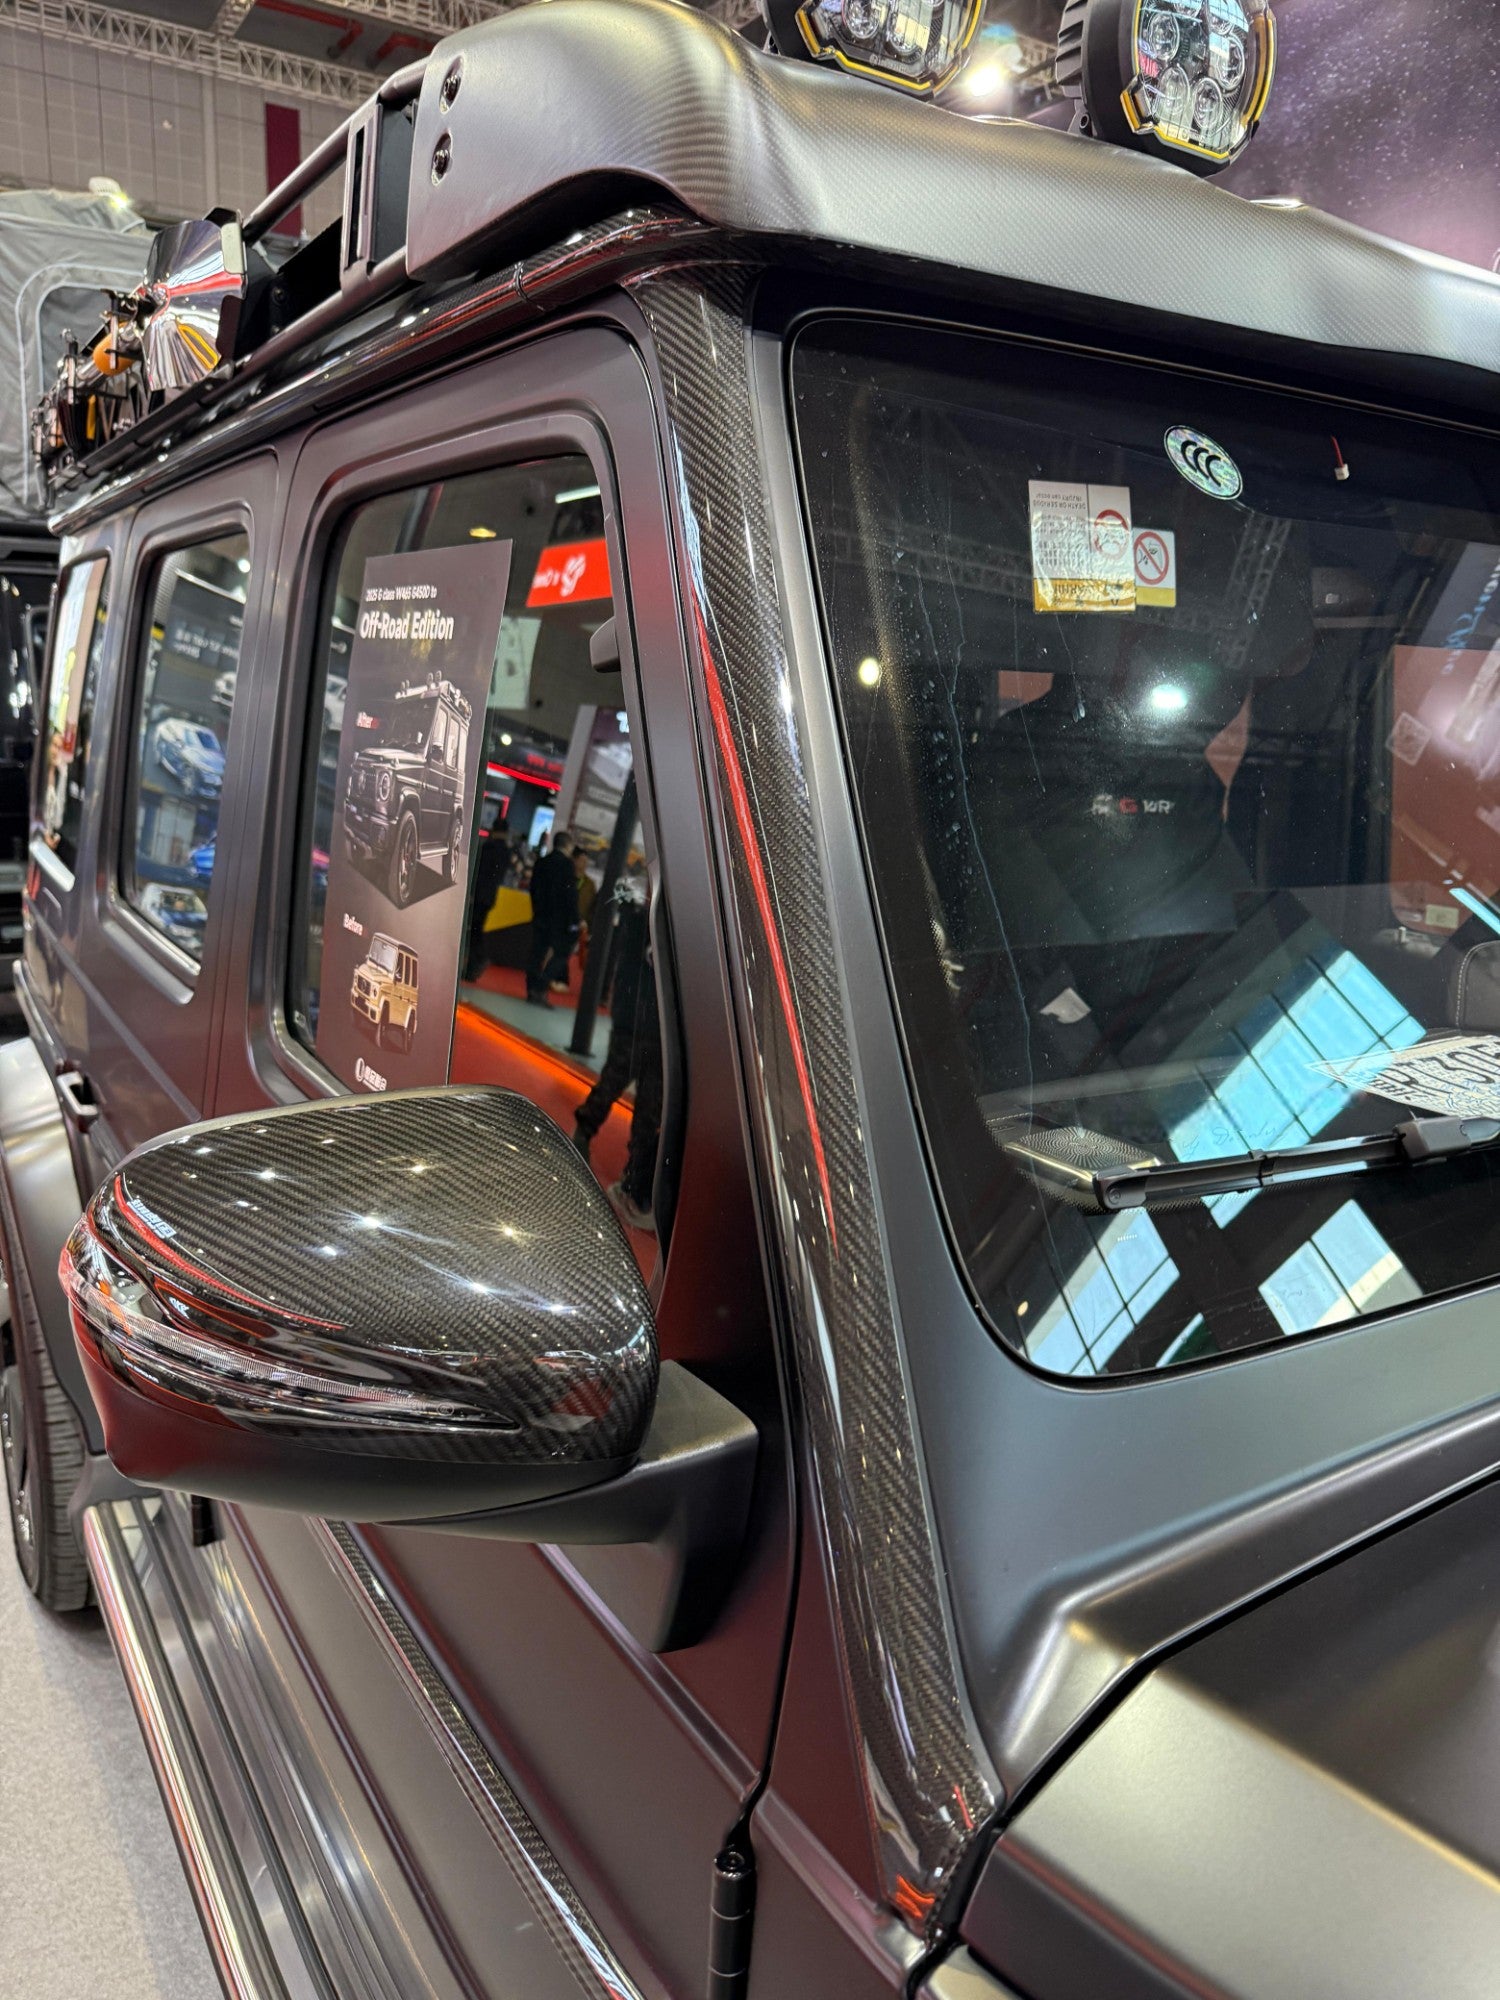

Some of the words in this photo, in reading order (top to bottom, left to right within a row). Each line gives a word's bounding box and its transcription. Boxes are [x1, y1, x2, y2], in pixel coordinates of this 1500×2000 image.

[430, 585, 438, 598] to
[359, 610, 410, 640] Off-Road
[411, 609, 455, 640] Edition
